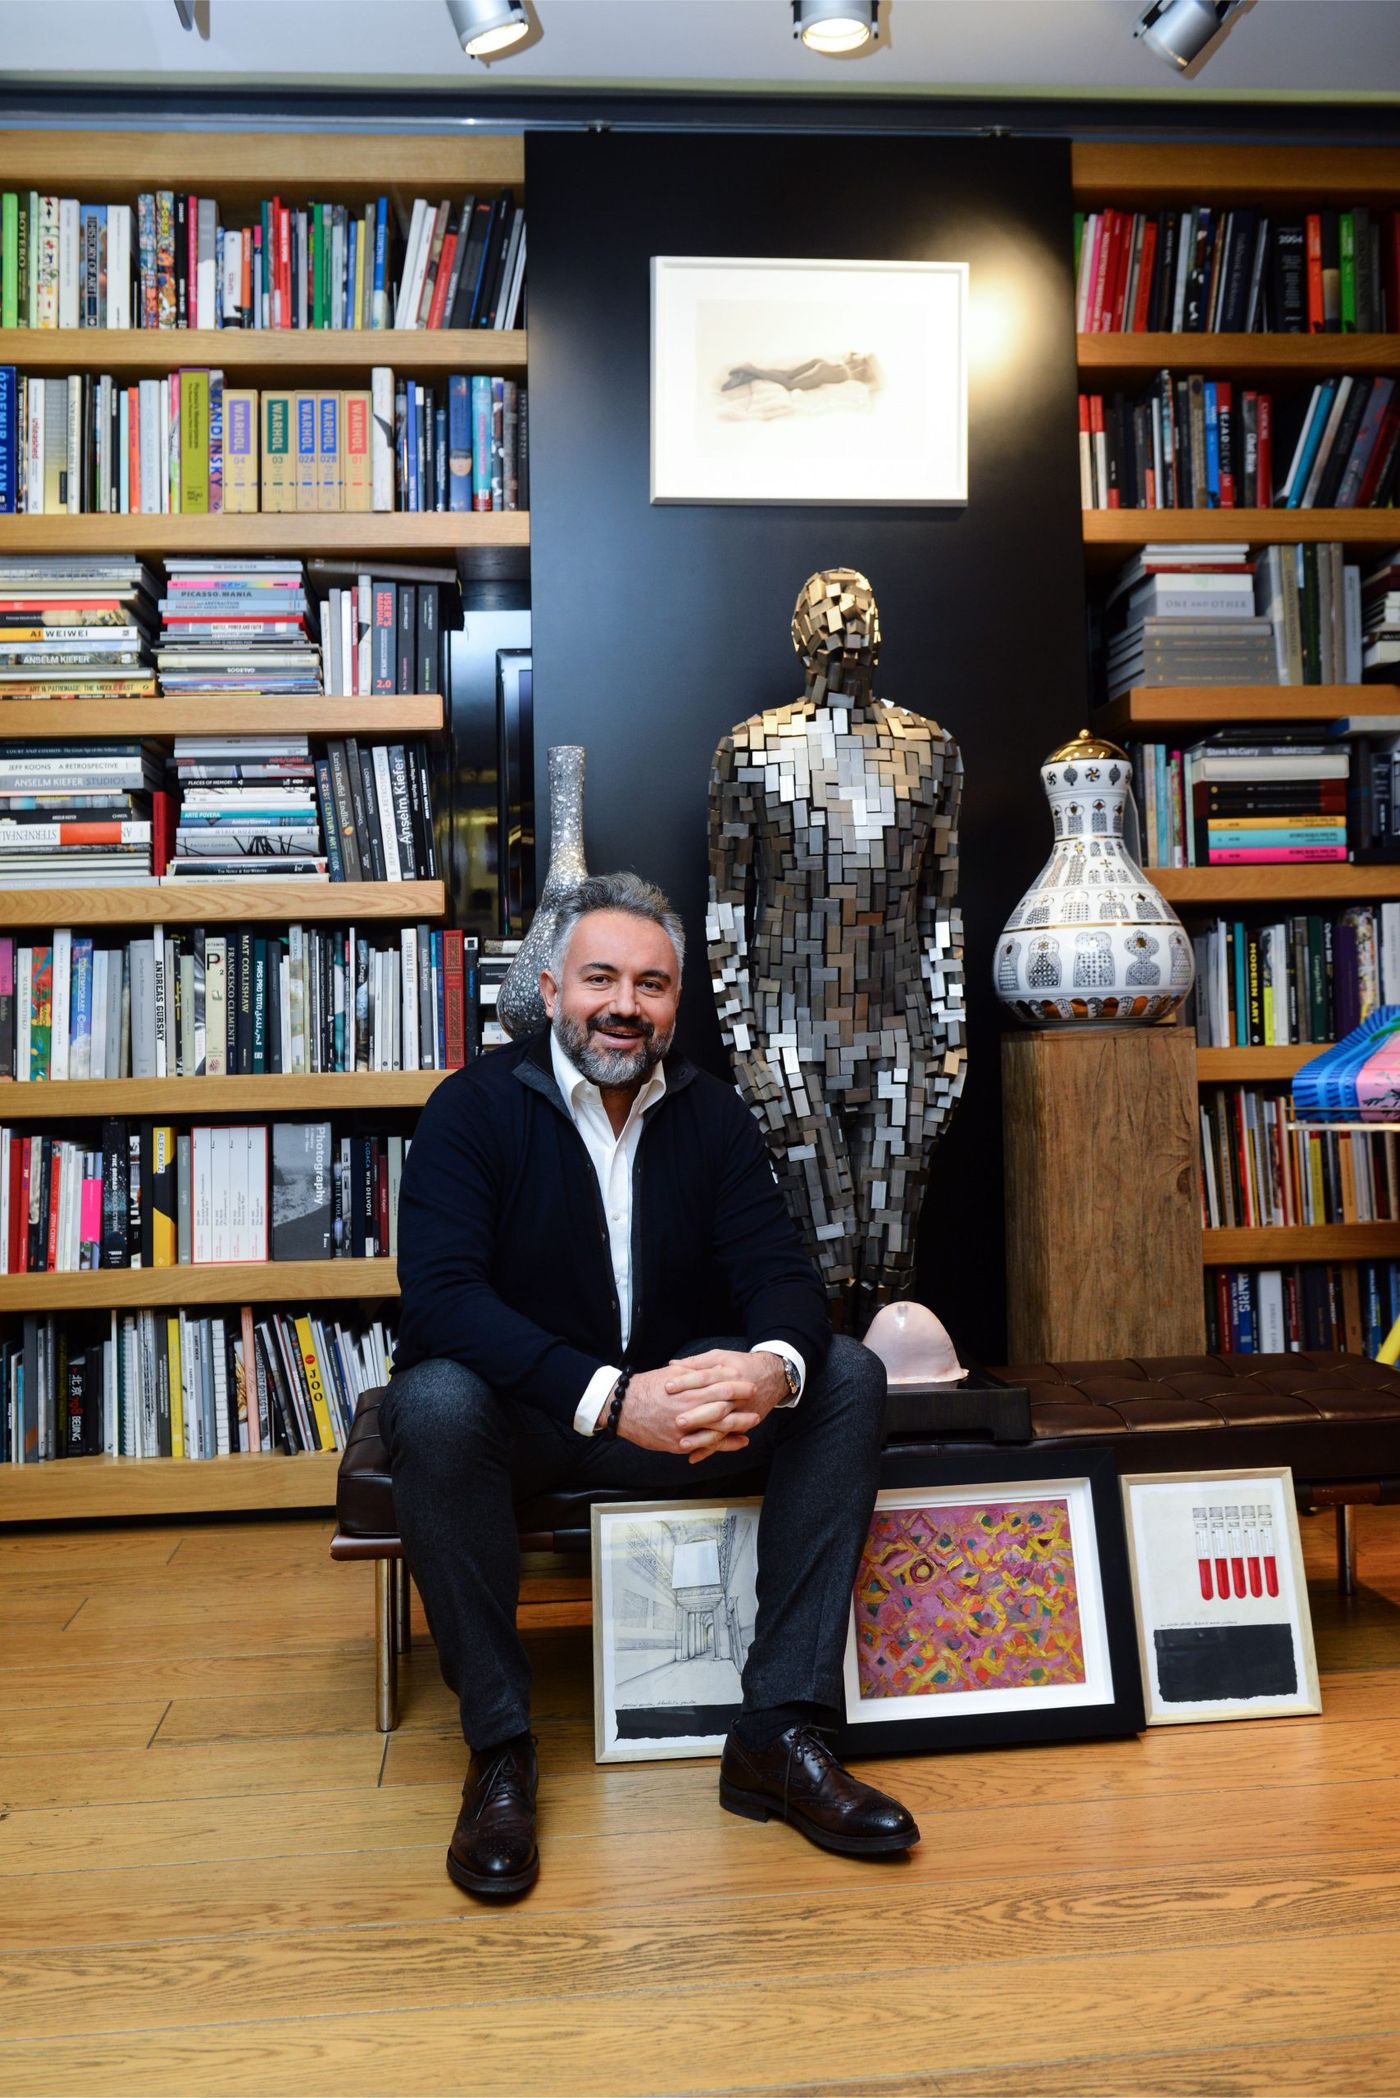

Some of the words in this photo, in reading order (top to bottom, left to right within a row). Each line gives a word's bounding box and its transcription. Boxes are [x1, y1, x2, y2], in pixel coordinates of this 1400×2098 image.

[18, 210, 28, 268] BOTERO
[86, 224, 97, 260] HISTORY
[86, 260, 97, 272] OF
[86, 280, 97, 294] ART
[32, 418, 40, 460] unleashed
[210, 388, 222, 488] KANDINSKY
[234, 402, 245, 450] WARHOL
[272, 402, 283, 450] WARHOL
[302, 402, 312, 450] WARHOL
[324, 402, 334, 449] WARHOL
[352, 403, 362, 450] WARHOL
[376, 592, 384, 626] MANUAL
[384, 592, 392, 626] USER'S
[1166, 600, 1188, 609] ONE
[1210, 600, 1248, 609] OTHER
[30, 630, 42, 638] AI
[46, 628, 88, 638] WEIWEI
[23, 655, 60, 664] ANSELM
[60, 654, 90, 664] KIEFER
[333, 752, 341, 772] Karin
[1206, 748, 1228, 756] Steve
[1228, 747, 1259, 756] McCurry
[64, 762, 118, 770] RETROSPECTIVE
[392, 756, 406, 794] Kiefer
[14, 779, 52, 788] ANSELM
[53, 778, 84, 787] KIEFER
[86, 777, 126, 786] STUDIOS
[335, 772, 345, 798] Kneffel
[362, 768, 370, 788] LORNA
[366, 788, 374, 815] SIMPSON
[324, 802, 334, 834] CENTURY
[339, 800, 349, 828] Endlich
[396, 798, 412, 844] Anselm
[328, 836, 336, 850] ART
[242, 935, 250, 956] MAT
[406, 942, 414, 966] THOMAS
[421, 948, 429, 968] Anish
[154, 960, 164, 1002] ANDREAS
[228, 947, 236, 998] FRANCESCO
[256, 961, 264, 978] PARS
[358, 964, 366, 984] Cragg
[421, 967, 429, 992] Kapoor
[1249, 942, 1258, 998] MODERN
[242, 957, 250, 1014] COLLISHAW
[256, 978, 264, 992] PRO
[0, 996, 8, 1022] Rothko
[1250, 1000, 1260, 1025] ART
[155, 1004, 164, 1042] GURSKY
[228, 1000, 236, 1048] CLEMENTE
[157, 1132, 165, 1152] ALEX
[157, 1153, 165, 1174] KATZ
[314, 1126, 326, 1205] Photography
[334, 1197, 342, 1221] VIOLA
[258, 1384, 268, 1416] OBJECTS
[72, 1416, 82, 1442] BEIJING
